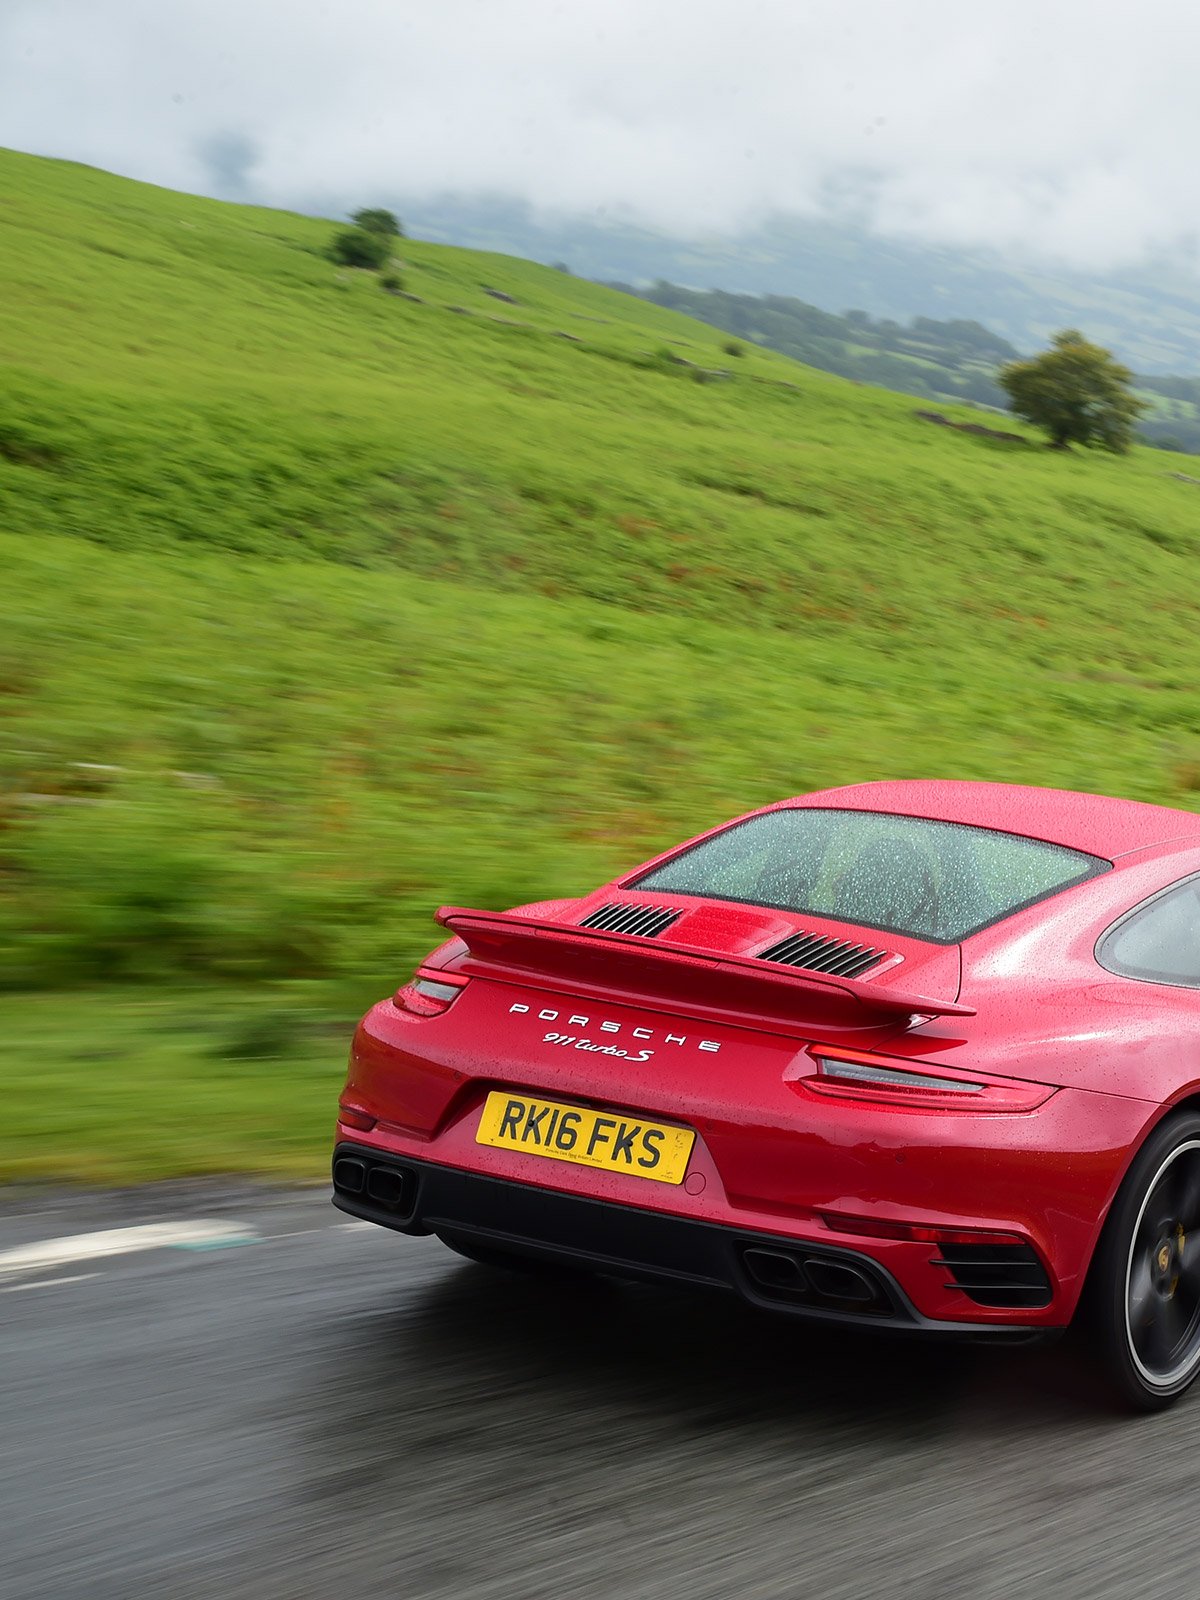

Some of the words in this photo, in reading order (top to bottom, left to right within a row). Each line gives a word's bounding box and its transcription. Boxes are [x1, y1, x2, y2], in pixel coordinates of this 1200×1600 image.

[509, 1003, 721, 1053] PORSCHE
[542, 1032, 577, 1047] 911
[575, 1038, 627, 1058] turbo
[624, 1049, 655, 1063] S
[498, 1100, 582, 1151] RK16
[586, 1117, 666, 1168] FKS
